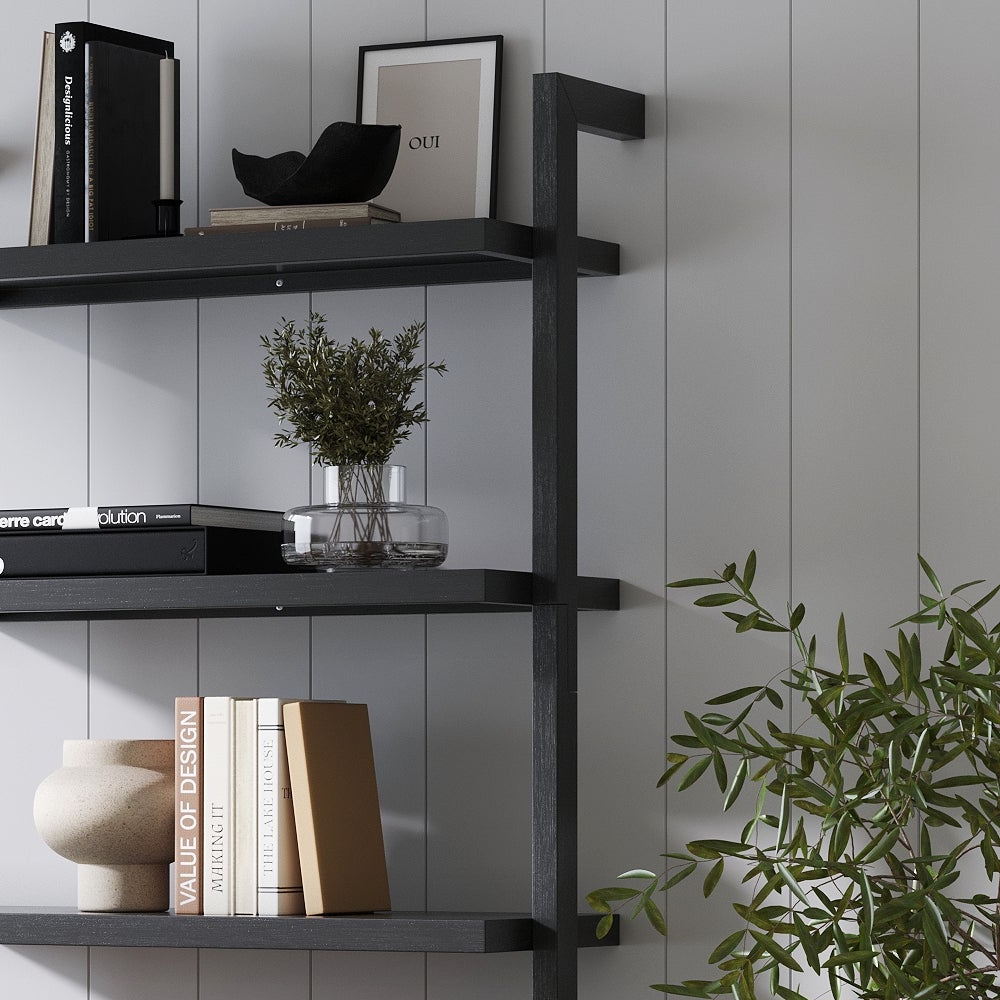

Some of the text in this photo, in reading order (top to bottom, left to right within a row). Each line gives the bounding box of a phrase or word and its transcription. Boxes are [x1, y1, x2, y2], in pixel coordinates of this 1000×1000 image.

[62, 75, 73, 146] Designlicious
[408, 135, 440, 150] OUI
[32, 510, 66, 527] card
[98, 508, 147, 525] olution
[263, 740, 273, 792] HOUSE
[180, 710, 197, 906] VALUE OF DESIGN
[211, 802, 223, 893] MAKING IT
[263, 843, 273, 876] THE
